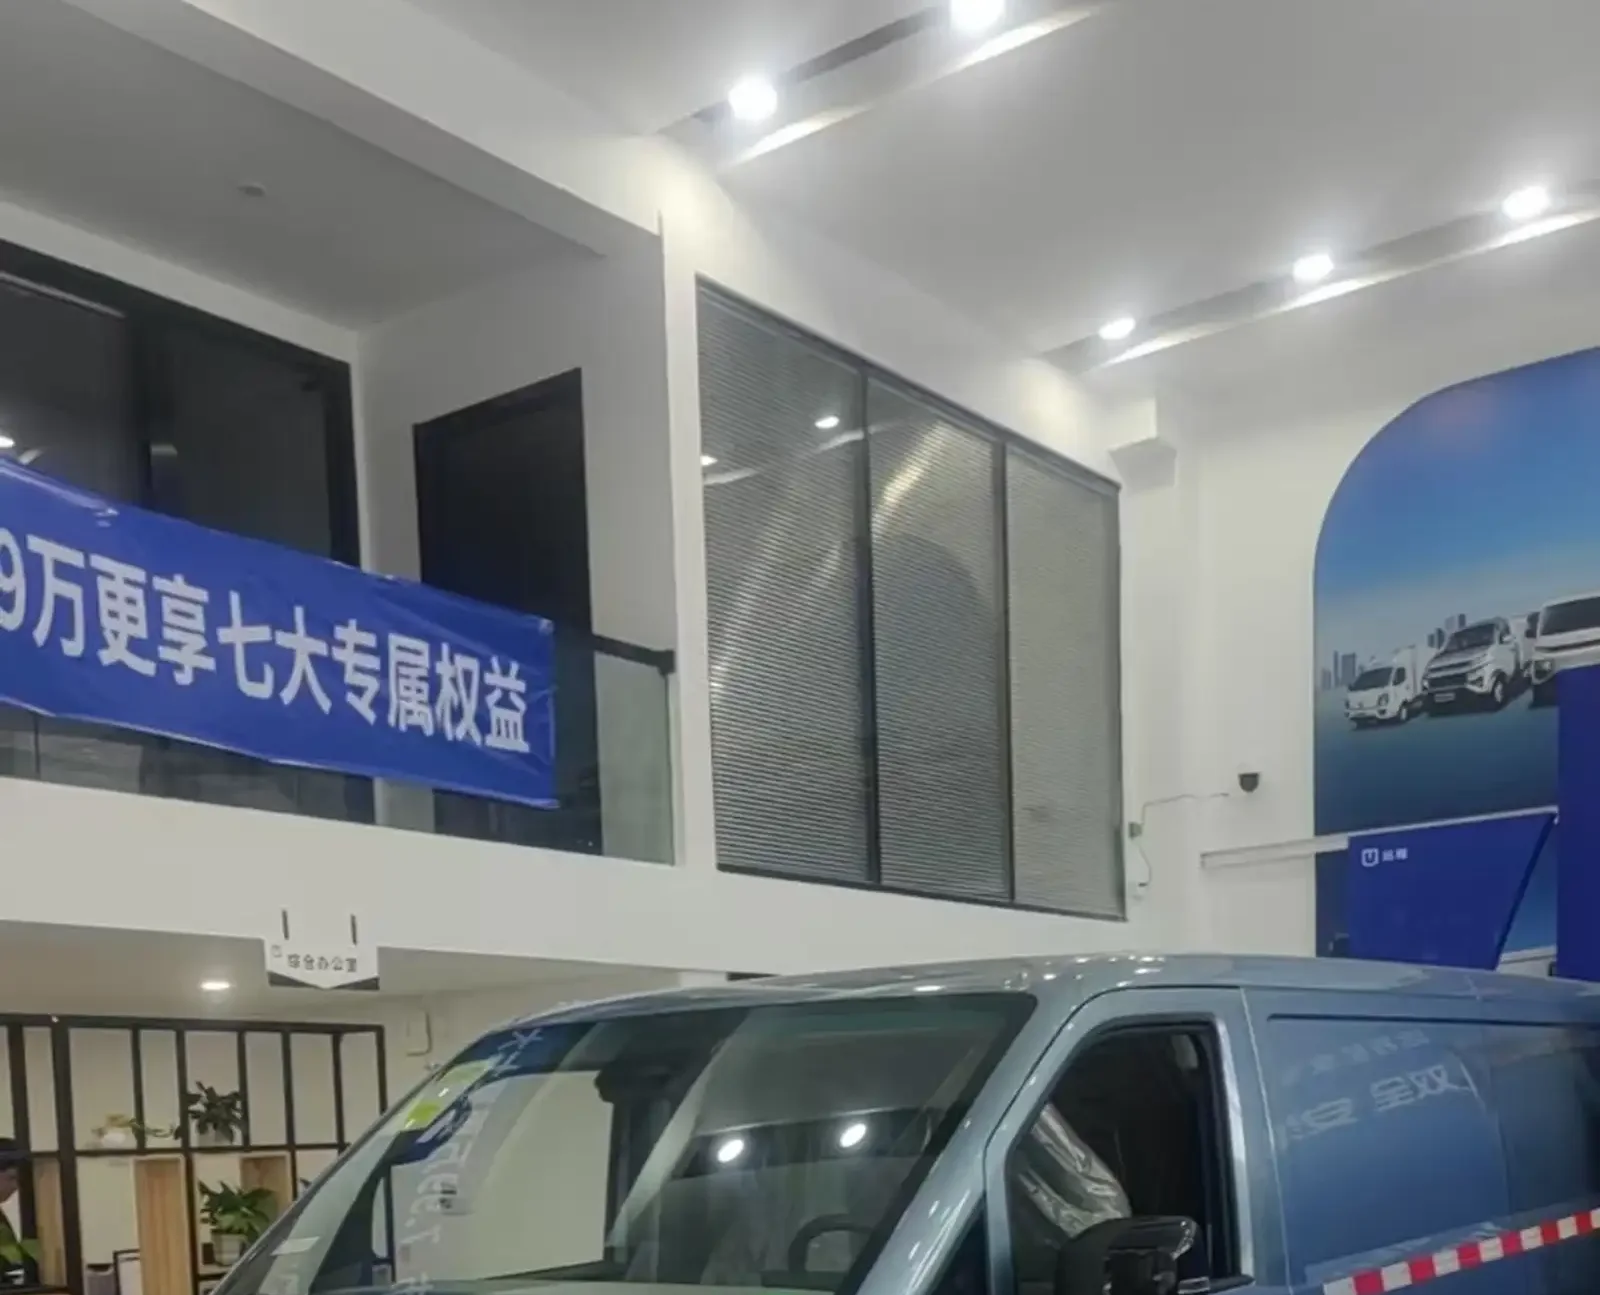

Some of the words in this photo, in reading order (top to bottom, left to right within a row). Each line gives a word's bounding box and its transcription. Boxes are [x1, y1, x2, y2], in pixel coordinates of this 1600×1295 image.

[0, 528, 530, 753] 9万更享七大专属权益
